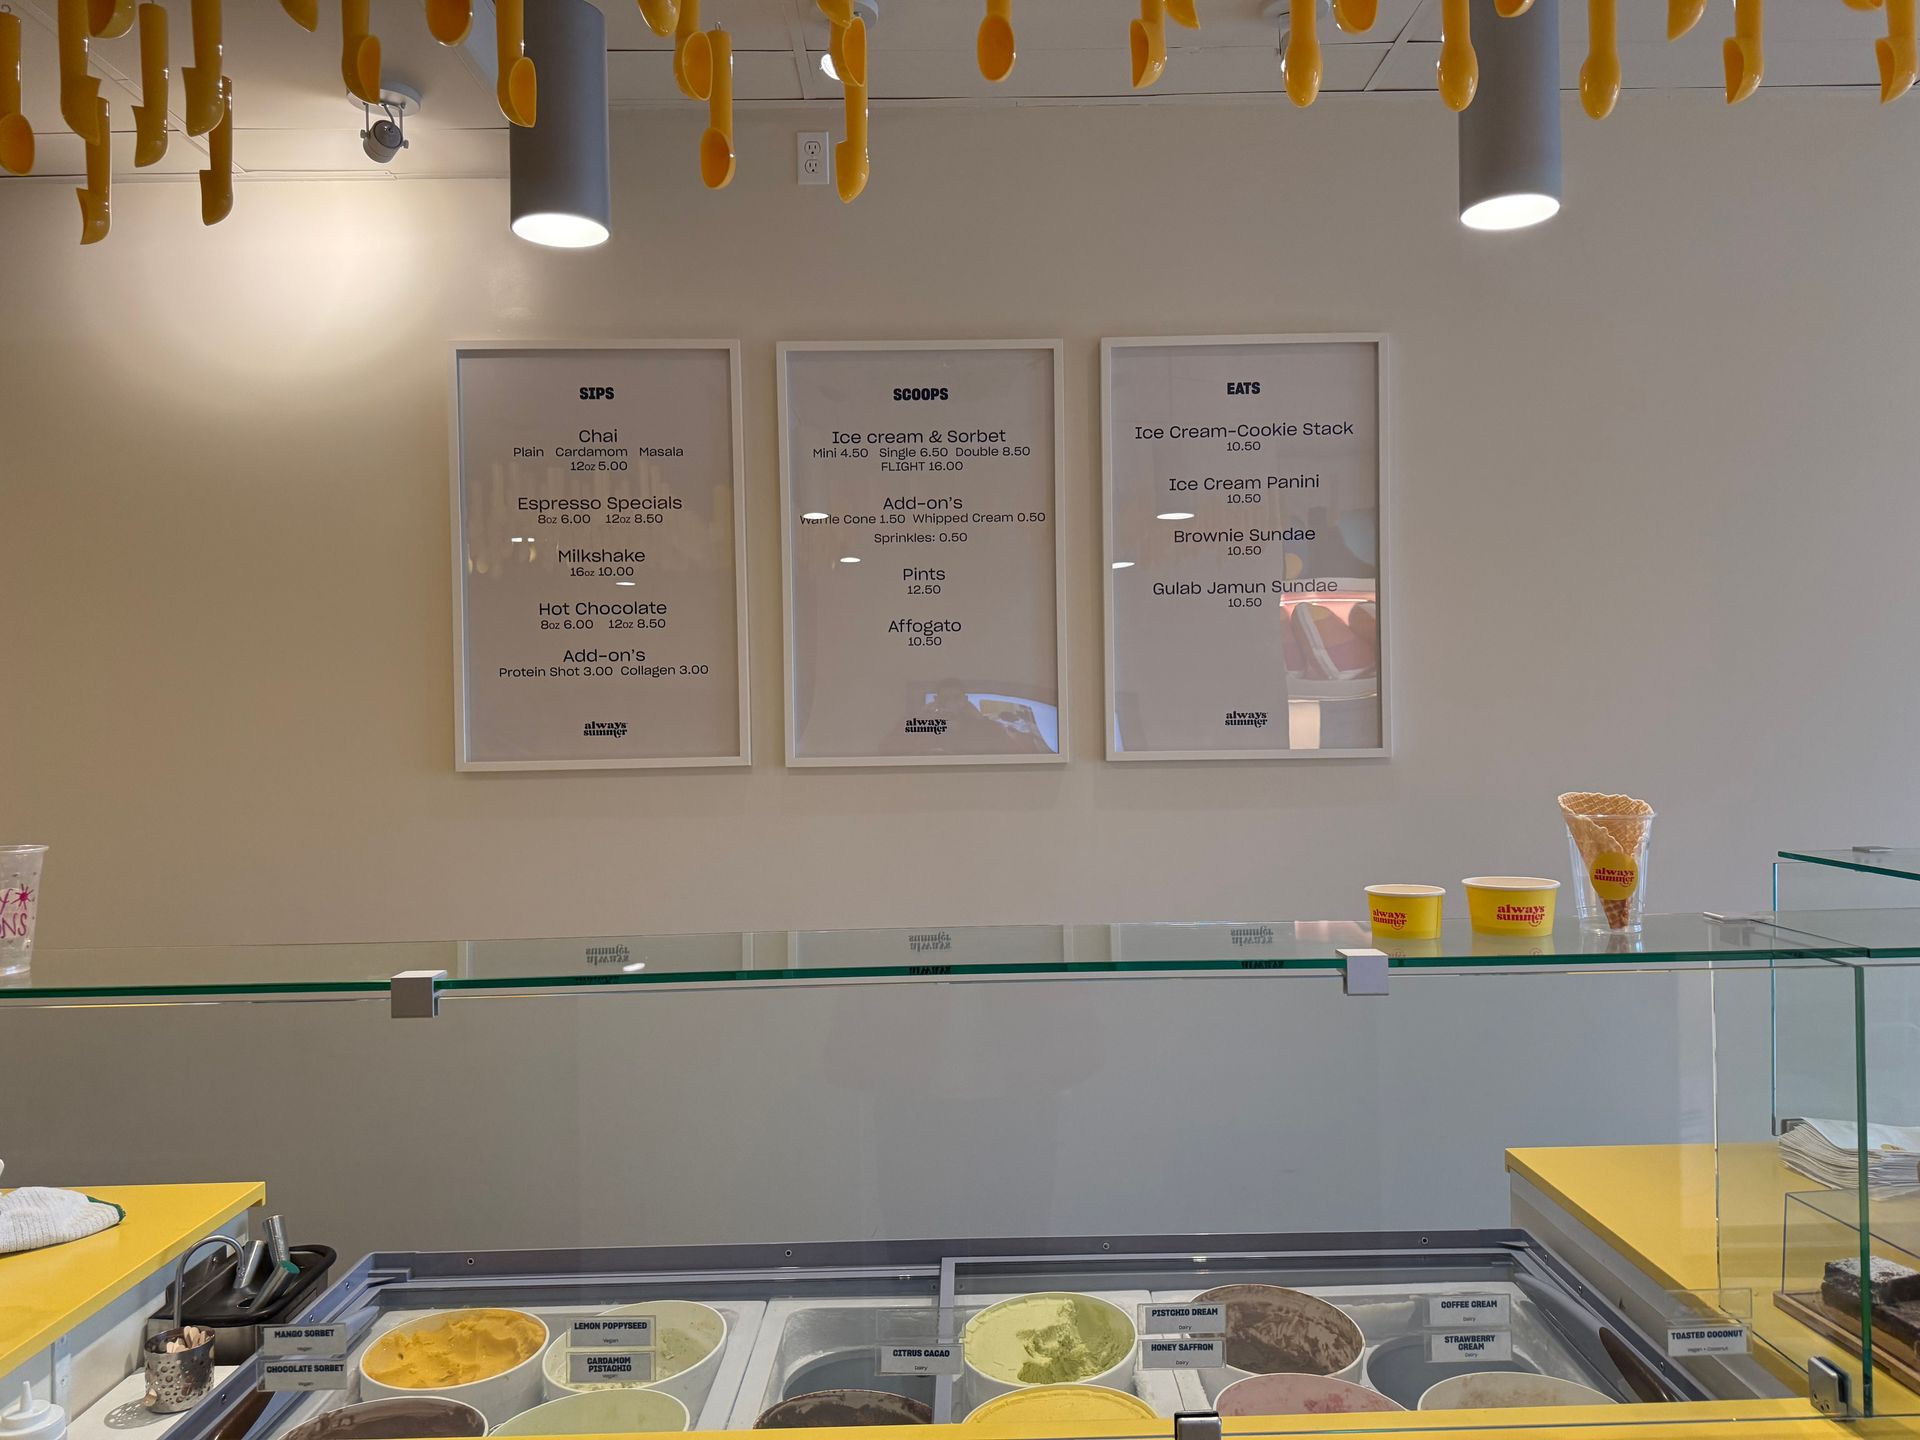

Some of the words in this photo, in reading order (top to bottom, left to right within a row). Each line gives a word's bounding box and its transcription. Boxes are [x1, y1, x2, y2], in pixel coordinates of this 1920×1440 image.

[579, 386, 615, 401] SIPS
[1226, 381, 1261, 395] EATS
[893, 387, 949, 402] SCOOPS
[578, 428, 618, 443] Chai
[1135, 426, 1165, 440] Ice
[1169, 422, 1298, 439] Cream-Cookie
[1302, 421, 1354, 436] Stack
[831, 431, 862, 445] Ice
[866, 432, 924, 444] cream
[928, 430, 943, 444] &
[947, 429, 1007, 444] Sorbet
[1226, 440, 1261, 452] 10.50
[513, 446, 545, 458] Plain
[555, 446, 628, 457] Cardamom
[639, 446, 684, 457] Masala
[813, 447, 837, 459] Mini
[839, 447, 869, 458] 4.50
[879, 447, 917, 461] Single
[919, 447, 949, 458] 6.50
[955, 446, 999, 457] Double
[1002, 446, 1031, 457] 8.50
[570, 460, 596, 472] 12oz
[598, 460, 628, 471] 5.00
[881, 461, 926, 472] FLIGHT
[928, 460, 964, 472] 16.00
[1168, 478, 1199, 492] Ice
[1203, 477, 1262, 491] Cream
[1267, 473, 1320, 489] Panini
[882, 496, 963, 510] Add-on's
[1226, 493, 1262, 504] 10.50
[518, 497, 602, 514] Espresso
[606, 495, 683, 513] Specials
[537, 514, 558, 525] 8oz
[560, 513, 591, 525] 6.00
[605, 513, 631, 524] 12oz
[634, 513, 664, 524] 8.50
[843, 514, 877, 525] Cone
[879, 514, 906, 524] 1.50
[912, 512, 969, 526] Whipped
[971, 512, 1014, 523] Cream
[1017, 512, 1046, 523] 0.50
[874, 532, 936, 545] Sprinkles:
[938, 532, 968, 543] 0.50
[1174, 528, 1244, 543] Brownie
[1249, 527, 1316, 542] Sundae
[558, 548, 646, 563] Milkshake
[1227, 545, 1262, 556] 10.50
[570, 566, 595, 577] 16oz
[598, 566, 635, 577] 10.00
[903, 567, 946, 581] Pints
[907, 584, 942, 595] 12.50
[1152, 581, 1202, 596] Gulab
[1206, 581, 1266, 595] Jamun
[1271, 578, 1338, 594] Sundae
[539, 602, 570, 616] Hot
[575, 600, 668, 616] Chocolate
[1228, 597, 1263, 608] 10.50
[540, 619, 560, 630] 8oz
[563, 619, 594, 630] 6.00
[608, 618, 634, 629] 12oz
[637, 618, 666, 629] 8.50
[888, 619, 962, 635] Affogato
[908, 636, 942, 646] 10.50
[562, 648, 646, 663] Add-on's
[499, 666, 546, 678] Protein
[549, 666, 580, 677] Shot
[583, 666, 614, 677] 3.00
[620, 665, 676, 679] Collagen
[679, 664, 709, 675] 3.00
[1225, 710, 1267, 719] always
[584, 720, 627, 730] always
[905, 717, 947, 726] always
[1224, 719, 1268, 728] summer
[583, 729, 628, 738] summer
[904, 726, 947, 735] summer
[1595, 867, 1633, 877] always
[1594, 874, 1634, 885] summer
[1373, 908, 1406, 919] always
[1497, 904, 1544, 914] always
[1373, 916, 1407, 927] summer
[1496, 913, 1545, 924] summer
[1441, 1300, 1469, 1309] COFFEE
[1471, 1299, 1497, 1308] CREAM
[1152, 1309, 1190, 1317] PISTCHIO
[1191, 1308, 1218, 1316] DREAM
[574, 1322, 600, 1330] LEMON
[602, 1322, 647, 1330] POPPYSEED
[274, 1330, 302, 1338] MANGO
[304, 1329, 335, 1337] SORBET
[1444, 1335, 1495, 1343] STRAWBERRY
[1671, 1331, 1705, 1340] TOASTED
[1707, 1330, 1743, 1338] COCONUT
[1151, 1343, 1177, 1351] HONEY
[1178, 1343, 1213, 1351] SAFFRON
[1458, 1343, 1485, 1351] CREAM
[893, 1349, 922, 1357] CITRUS
[924, 1349, 950, 1357] CACAO
[587, 1357, 631, 1365] CARDAMOM
[266, 1365, 312, 1373] CHOCOLATE
[314, 1364, 344, 1372] SORBET
[588, 1364, 632, 1373] PISTACHIO
